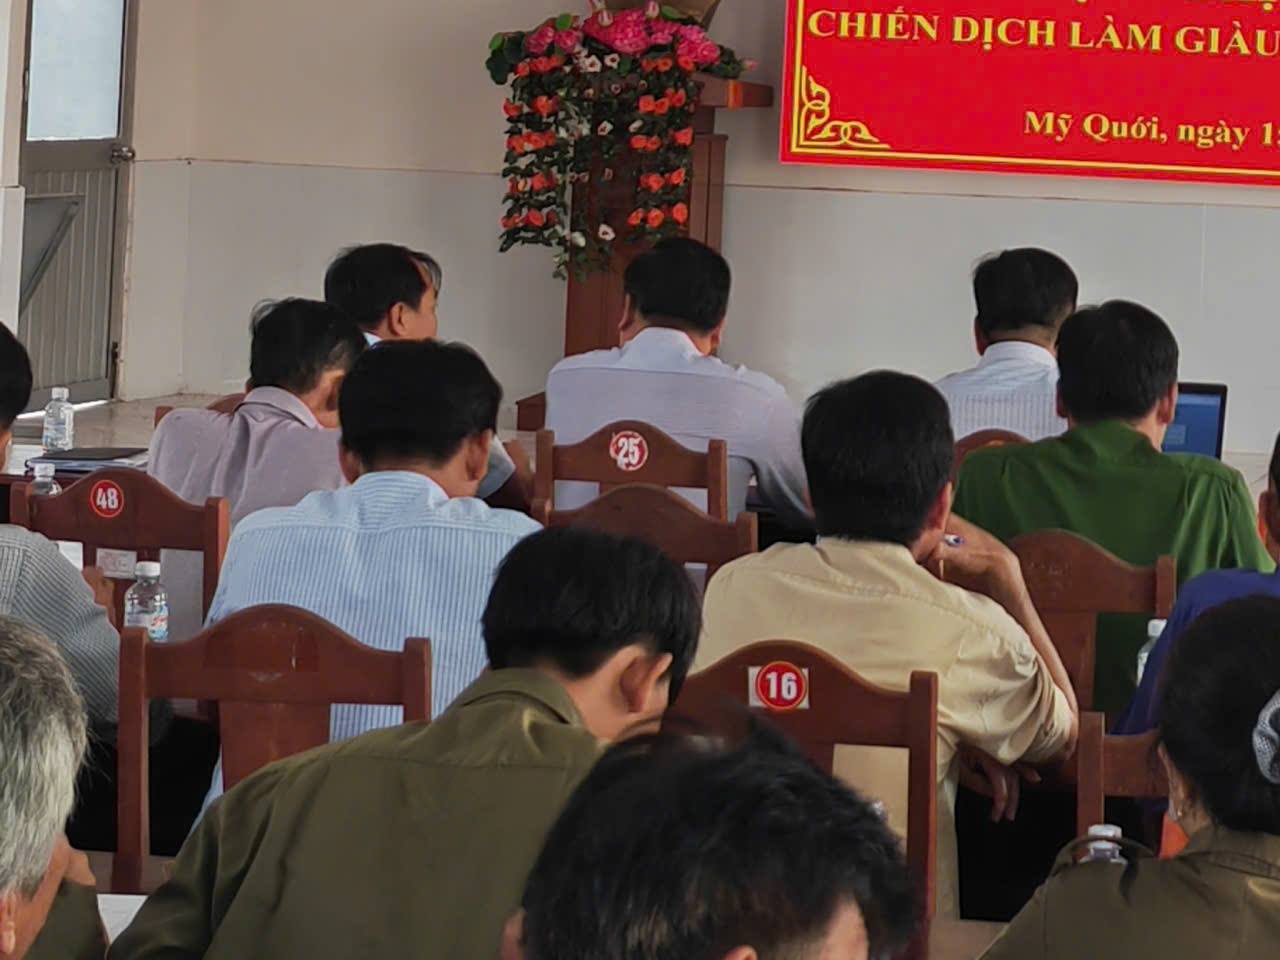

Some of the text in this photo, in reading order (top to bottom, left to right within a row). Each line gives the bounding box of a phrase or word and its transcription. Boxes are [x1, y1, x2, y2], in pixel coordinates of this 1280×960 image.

[807, 5, 939, 41] CHIẾN
[952, 14, 1057, 51] DỊCH
[1069, 15, 1162, 53] LÀM
[1024, 110, 1074, 142] Mỹ
[1082, 112, 1168, 144] Quới,
[1177, 119, 1250, 152] ngày
[616, 436, 641, 466] 25
[95, 486, 120, 511] 48
[765, 670, 798, 701] 16
